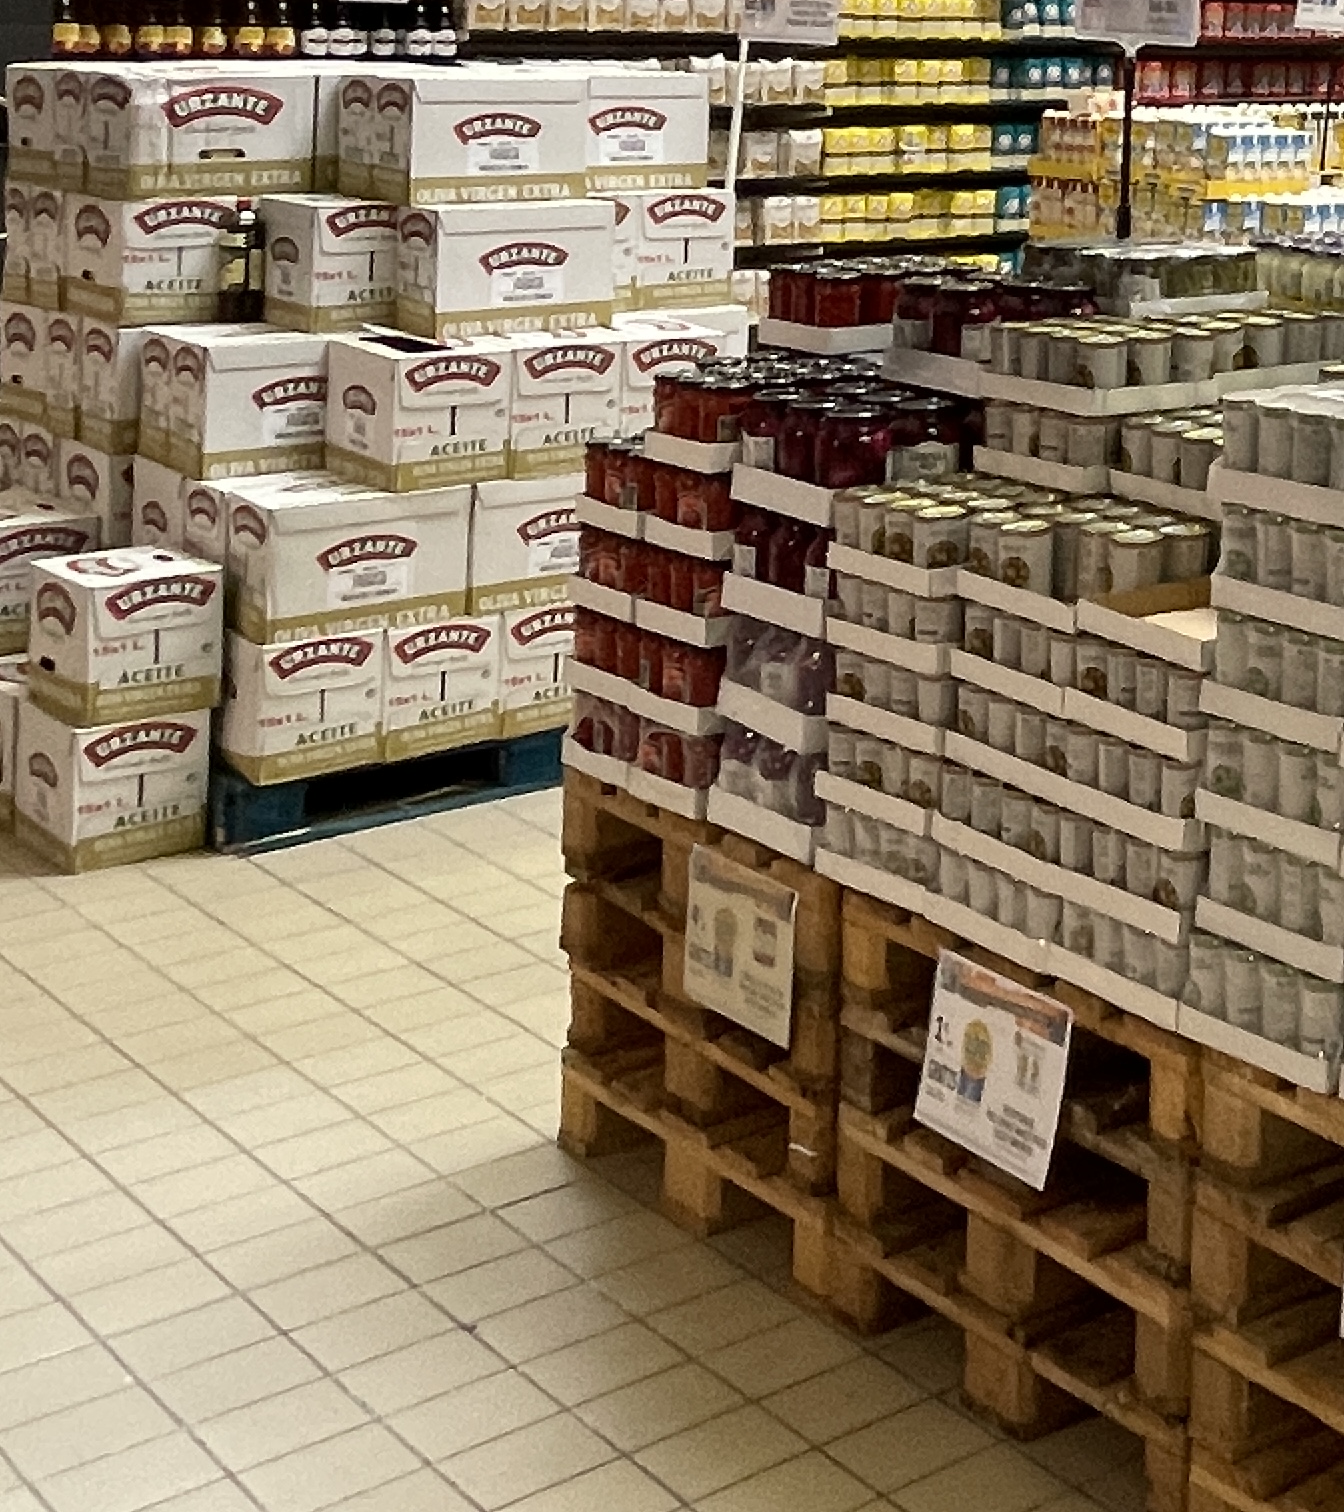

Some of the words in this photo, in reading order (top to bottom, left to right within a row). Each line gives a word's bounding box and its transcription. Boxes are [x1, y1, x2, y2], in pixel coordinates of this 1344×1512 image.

[173, 92, 268, 116] URZANTE
[463, 118, 530, 136] URZANTE
[597, 112, 657, 129] URZANTE
[595, 174, 644, 189] VIRGEN
[650, 173, 693, 187] EXTRA
[461, 186, 517, 201] VIRGEN
[523, 183, 570, 198] EXTRA
[658, 197, 718, 216] URZANTE
[489, 248, 557, 266] URZANTE
[667, 268, 714, 282] ACEITE
[550, 312, 597, 329] EXTRA
[533, 349, 603, 370] URZANTE
[415, 359, 488, 383] URZANTE
[431, 438, 487, 455] ACEITE
[328, 541, 404, 566] URZANTE
[121, 581, 205, 609] URZANTE
[405, 630, 478, 653] URZANTE
[280, 643, 359, 668] URZANTE
[118, 664, 185, 684] ACEITE
[419, 699, 474, 722] ACEITE
[96, 729, 184, 757] URZANTE
[295, 723, 356, 746] ACEITE
[114, 804, 180, 827] ACEITE
